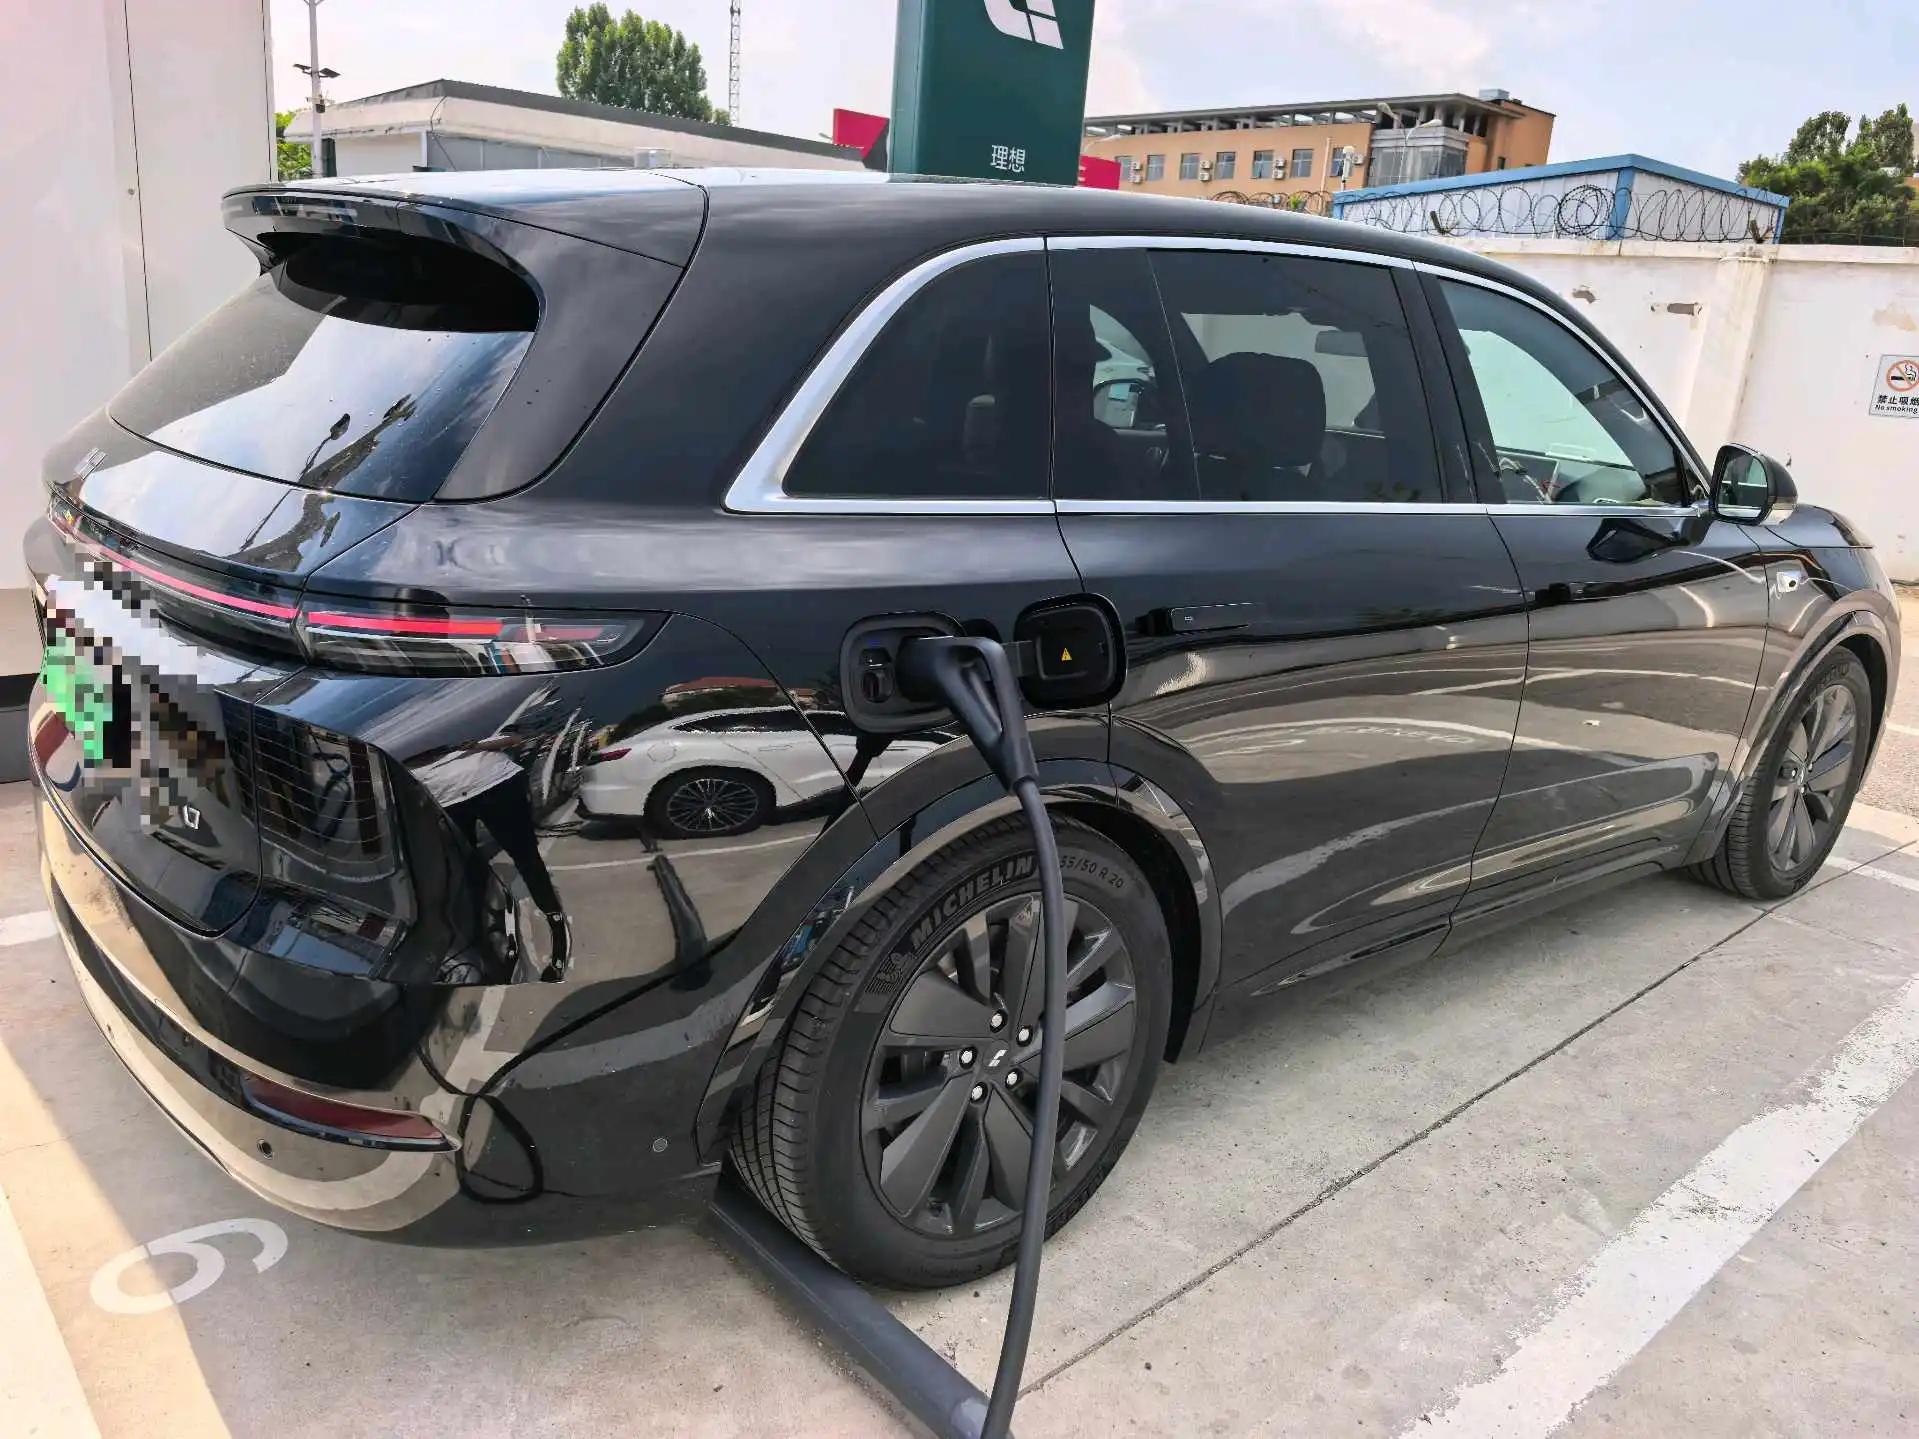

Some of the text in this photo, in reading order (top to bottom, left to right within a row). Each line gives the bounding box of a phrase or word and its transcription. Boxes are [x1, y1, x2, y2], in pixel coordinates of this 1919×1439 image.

[990, 144, 1026, 173] 理想
[1886, 404, 1918, 415] smoking
[1059, 855, 1097, 874] 55/50
[911, 856, 1034, 949] MICHELIN
